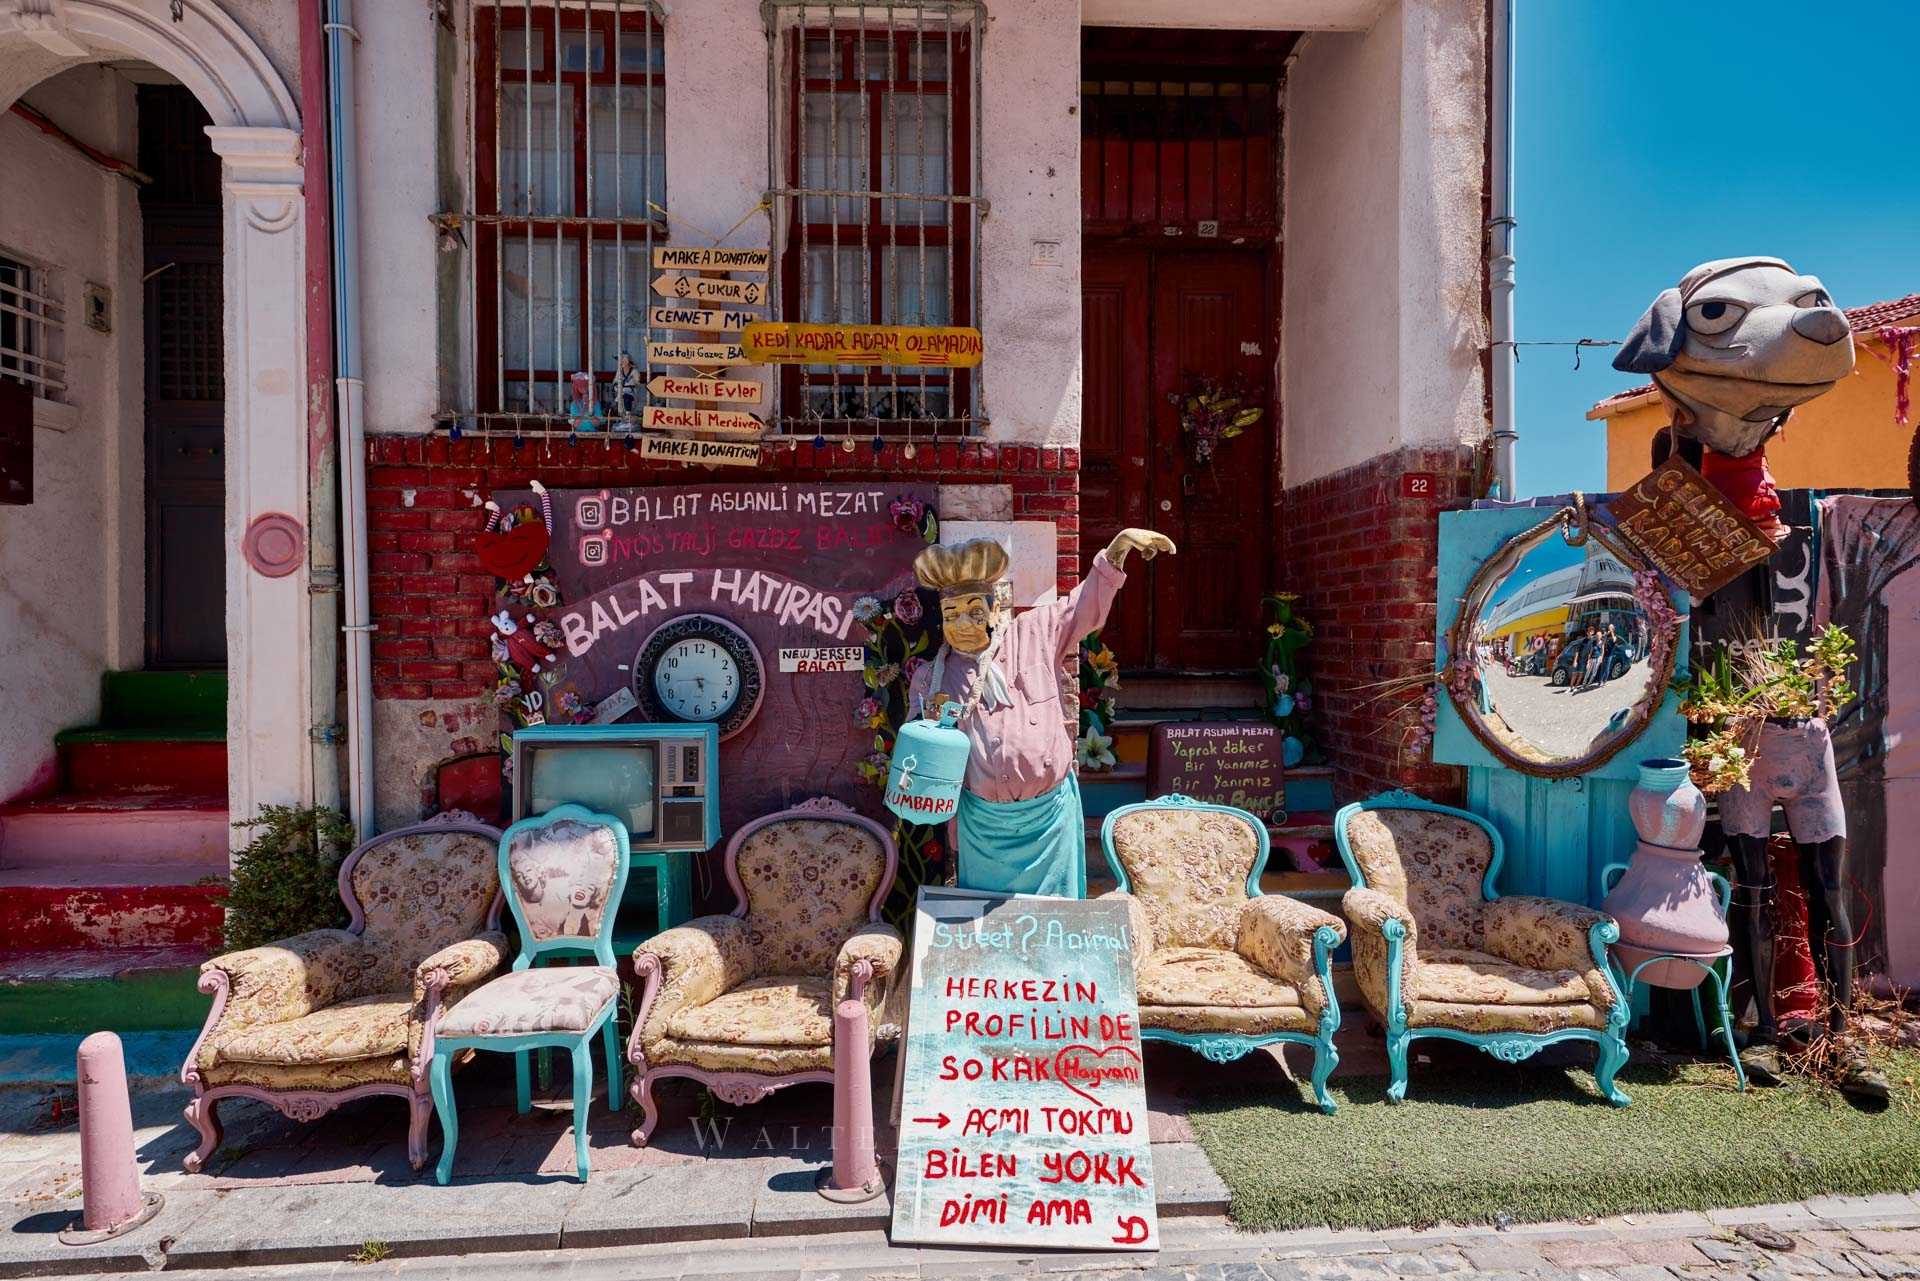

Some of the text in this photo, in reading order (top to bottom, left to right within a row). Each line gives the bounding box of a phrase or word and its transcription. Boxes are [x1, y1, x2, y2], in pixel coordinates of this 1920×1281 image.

[1201, 224, 1215, 235] 22
[662, 251, 700, 265] MAKE
[701, 250, 711, 264] A
[697, 282, 741, 297] ÇUKUR
[656, 311, 714, 325] CENNET
[795, 332, 847, 350] KADAR
[851, 332, 899, 352] ADAM
[905, 335, 984, 355] OLAMADIN
[664, 379, 757, 398] Renkli Evler
[653, 409, 760, 430] Renkli Merdiven
[648, 440, 688, 456] MAKE
[689, 441, 699, 456] A
[1411, 479, 1428, 492] 22
[611, 494, 702, 525] BALAT
[797, 491, 885, 517] MEZAT
[560, 569, 854, 658] BALAT HATIRASI
[679, 646, 688, 657] 11
[694, 643, 705, 654] 12
[712, 648, 717, 659] 1
[782, 648, 862, 660] NEW JERSEY
[668, 658, 678, 668] 10
[722, 660, 729, 670] 2
[797, 660, 847, 673] BALAT
[664, 673, 671, 683] 9
[726, 675, 732, 686] 3
[667, 689, 674, 700] 8
[722, 690, 729, 701] 4
[679, 700, 685, 710] 7
[694, 704, 701, 715] 6
[710, 702, 717, 712] 5
[1167, 728, 1200, 739] BALAT
[1223, 739, 1265, 754] döker
[1185, 761, 1206, 773] Bir
[1172, 776, 1200, 792] Bir
[885, 792, 954, 814] KUMBARA
[933, 922, 1013, 950] Street
[1036, 919, 1130, 951] Animal
[1040, 1107, 1134, 1136] TOKMU
[1038, 1150, 1146, 1187] YOKK
[1027, 1199, 1093, 1226] AMA
